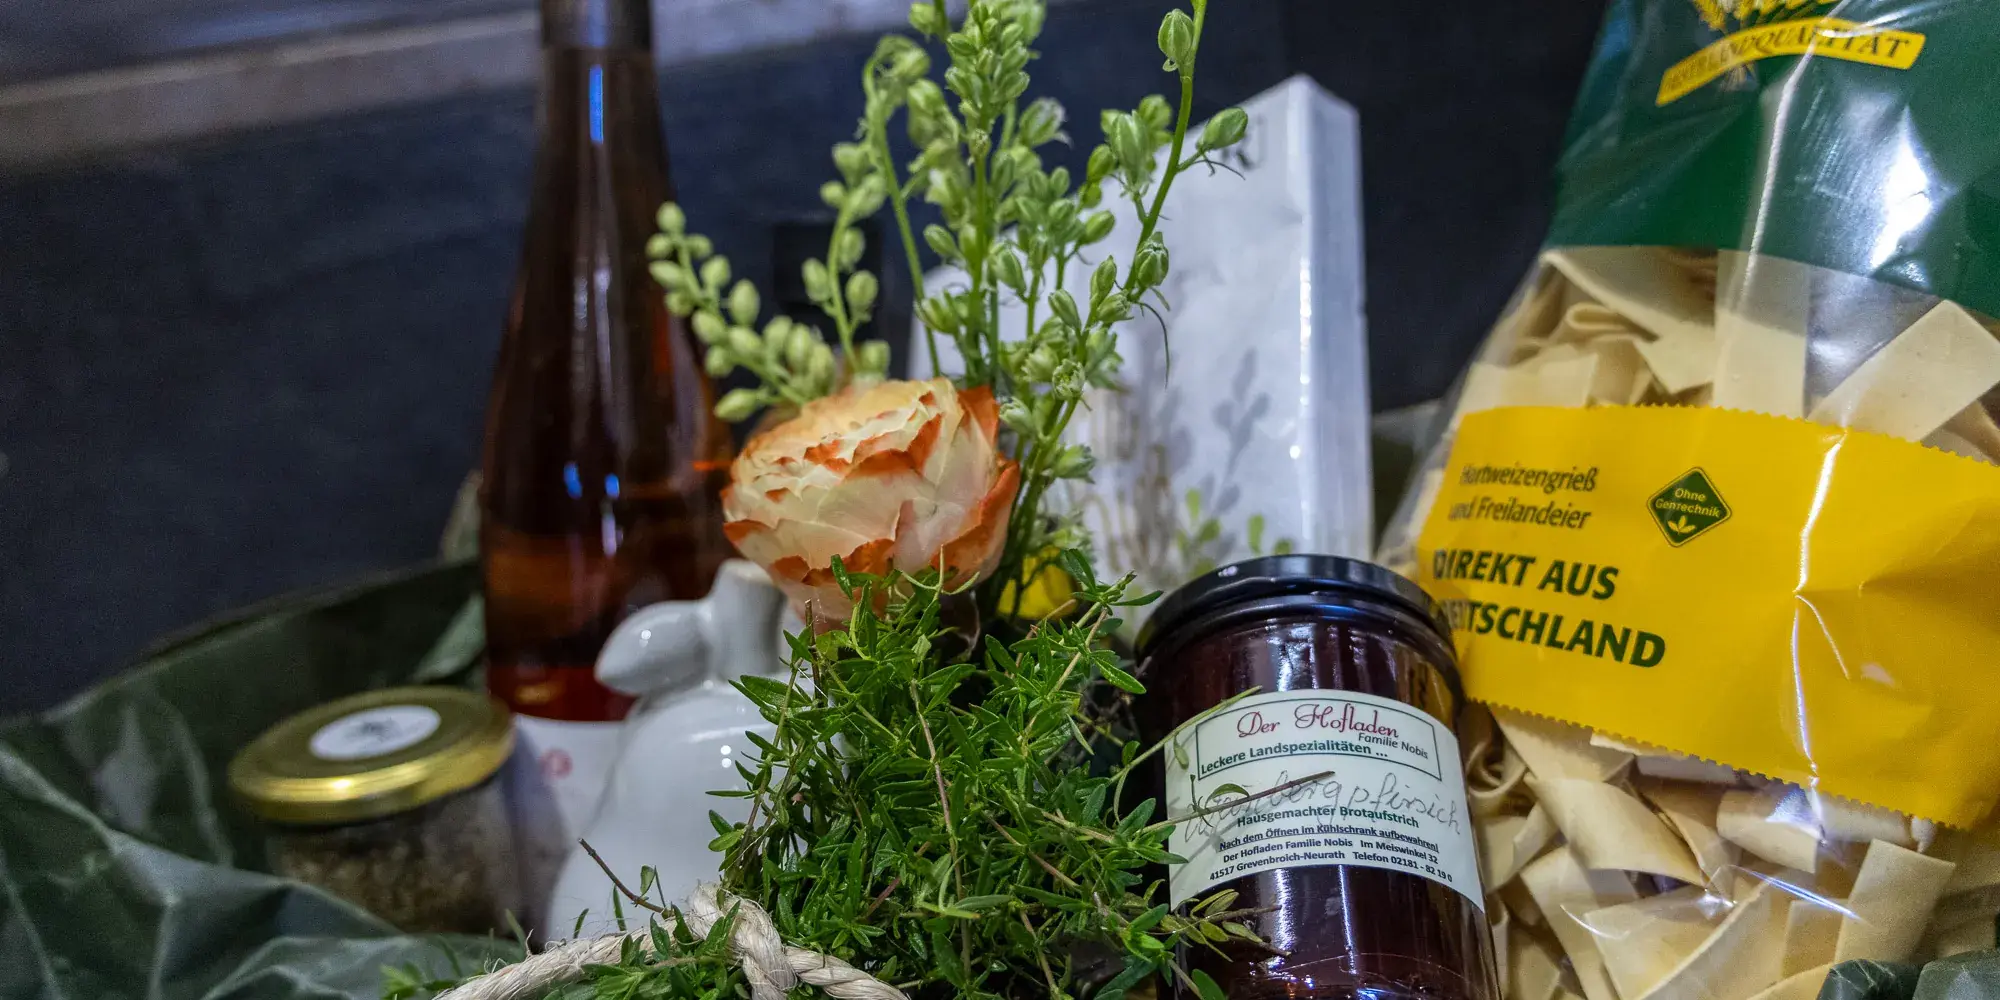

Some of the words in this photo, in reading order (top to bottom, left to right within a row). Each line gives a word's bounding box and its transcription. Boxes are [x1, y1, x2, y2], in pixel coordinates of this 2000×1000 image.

[1655, 498, 1720, 518] Gentechnik
[1675, 488, 1706, 502] Ohne
[1476, 496, 1591, 530] Freilandeier
[1433, 548, 1536, 586] DIREKT
[1537, 560, 1619, 600] AUS
[1237, 711, 1280, 738] Der
[1294, 703, 1399, 738] Hofladen
[1201, 751, 1246, 775] Leckere
[1249, 740, 1372, 758] Landspezialitäten
[1358, 732, 1398, 748] Familie
[1401, 742, 1429, 759] Nobis
[1237, 805, 1337, 828] Hausgemachter
[1340, 806, 1419, 829] Brotaufstrich
[1219, 836, 1241, 851] Nach
[1243, 831, 1263, 845] dem
[1265, 827, 1300, 840] Öffnen
[1301, 825, 1315, 834] im
[1317, 824, 1377, 837] Kühlschrank
[1223, 851, 1239, 863] Der
[1240, 843, 1284, 858] Hofladen
[1285, 838, 1321, 850] Familie
[1323, 837, 1353, 848] Nobis
[1360, 839, 1374, 849] Im
[1375, 842, 1427, 860] Meiswinkel
[1428, 853, 1439, 865] 32
[1209, 865, 1235, 881] 41517
[1236, 850, 1346, 872] Grevenbroich-Neurath
[1352, 851, 1389, 864] Telefon
[1390, 856, 1419, 870] 02181
[1425, 864, 1436, 875] 82
